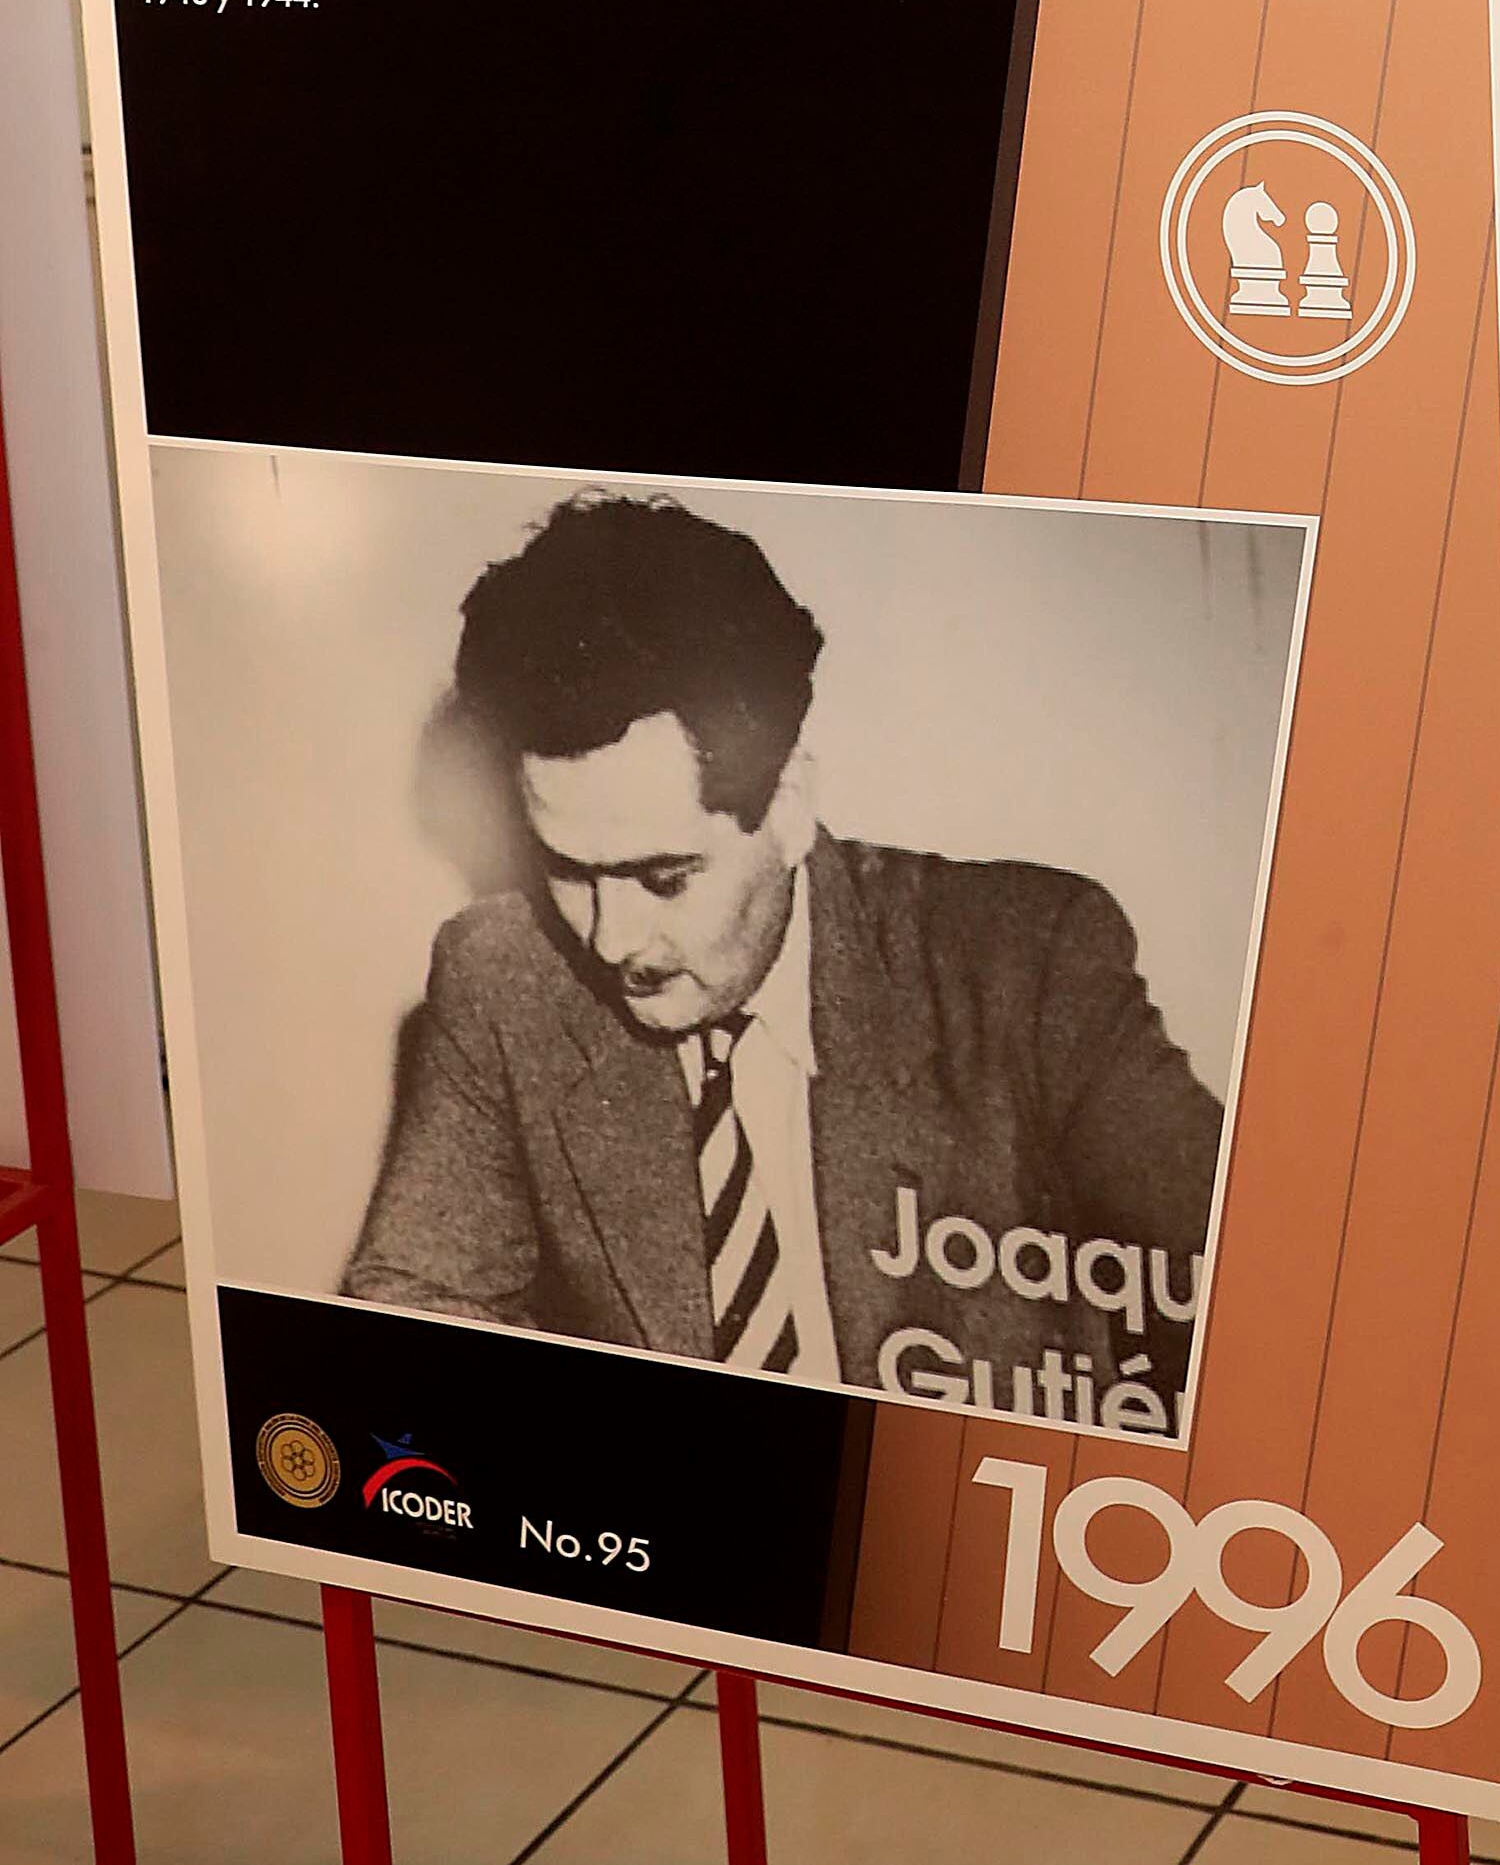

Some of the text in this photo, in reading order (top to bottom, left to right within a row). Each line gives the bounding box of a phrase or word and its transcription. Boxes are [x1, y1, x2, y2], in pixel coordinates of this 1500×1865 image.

[381, 1487, 474, 1529] ICODER
[520, 1515, 650, 1572] No.95
[971, 1457, 1481, 1729] 1996
